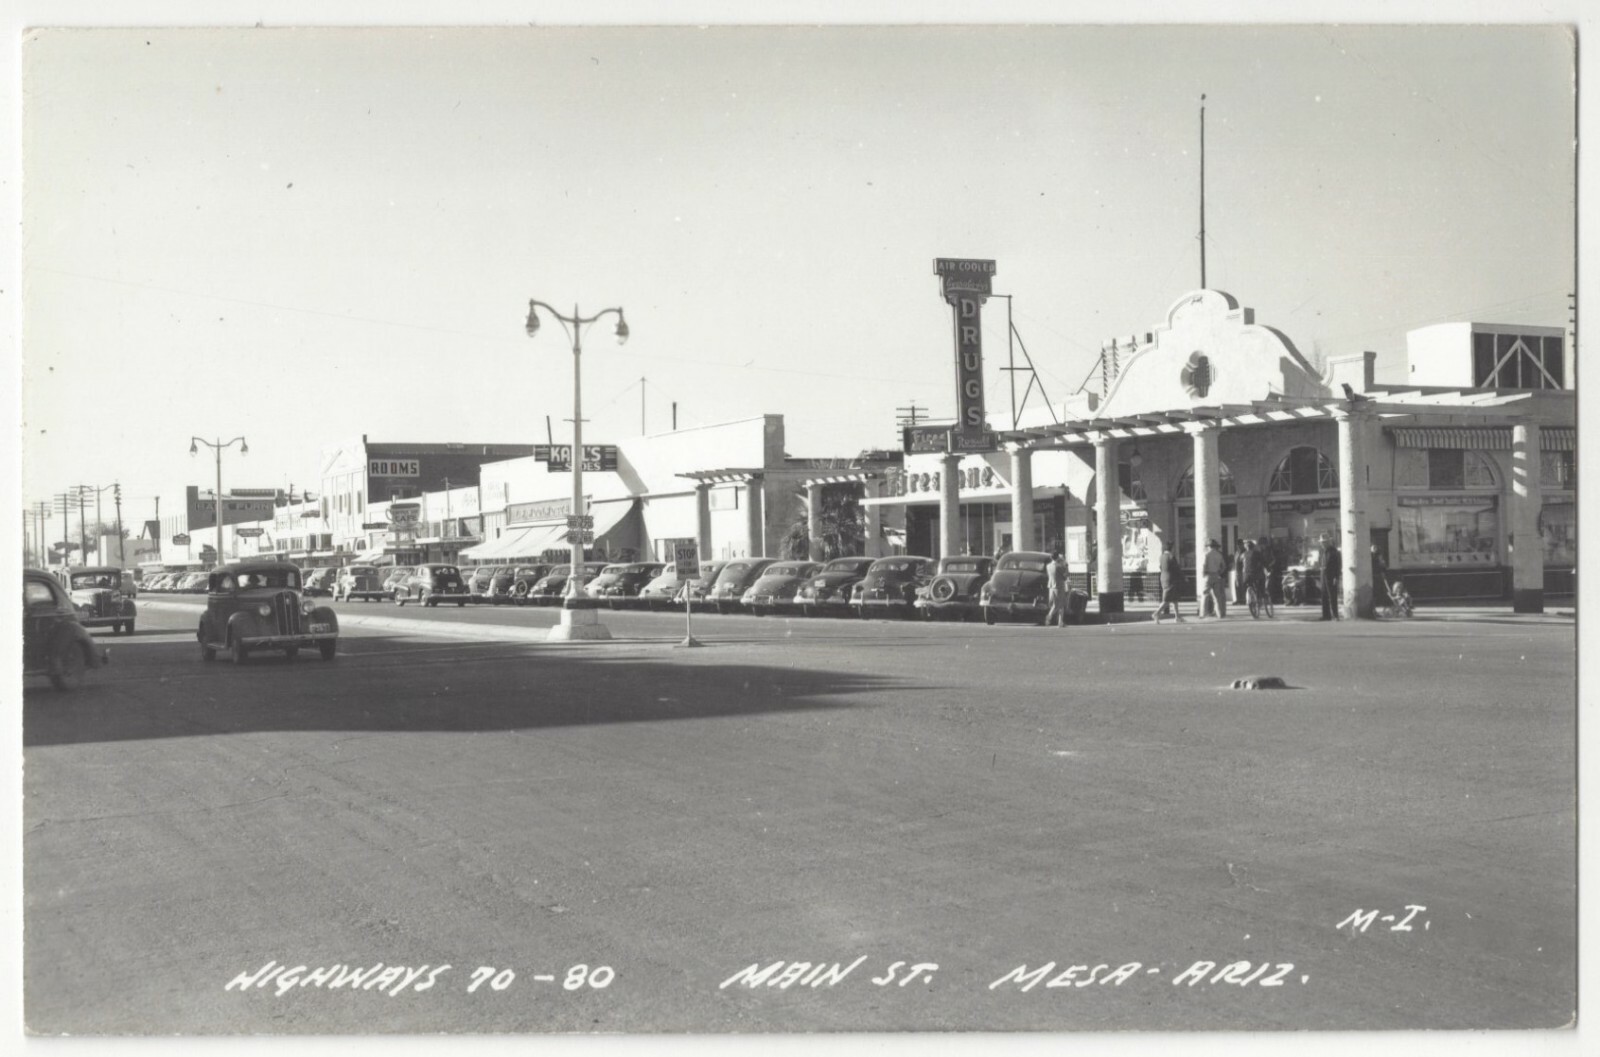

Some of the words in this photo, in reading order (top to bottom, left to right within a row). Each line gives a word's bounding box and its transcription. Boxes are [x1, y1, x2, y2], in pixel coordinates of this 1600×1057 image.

[938, 261, 956, 272] AIR
[958, 261, 996, 272] COOLED
[961, 298, 981, 425] DRUGS
[550, 446, 602, 462] KAL'S
[371, 461, 418, 475] ROOMS
[565, 462, 601, 472] SOES
[677, 548, 696, 560] STOP
